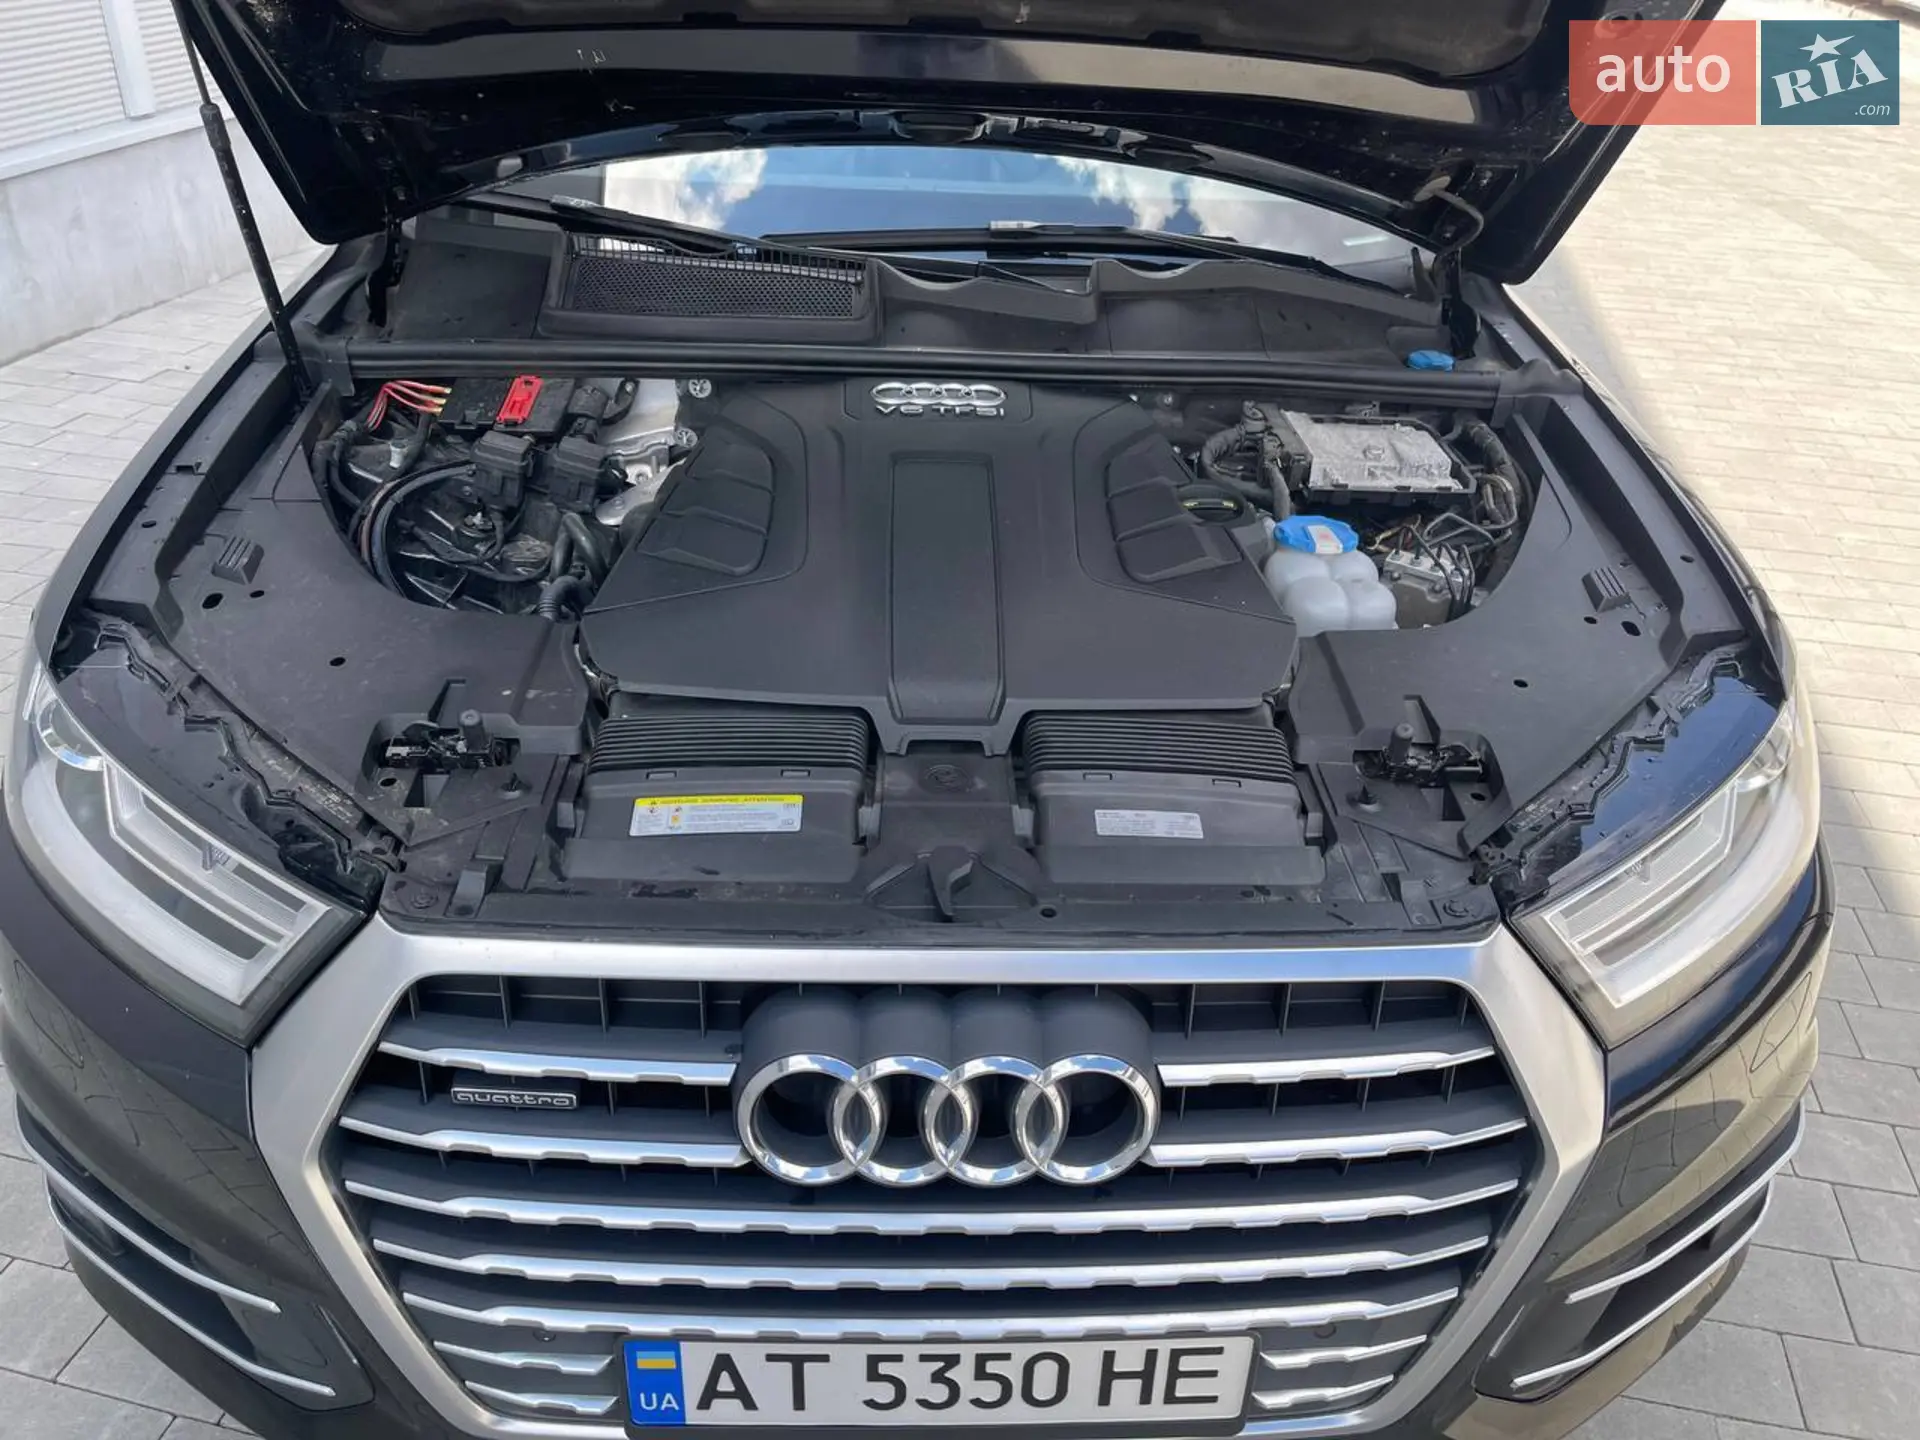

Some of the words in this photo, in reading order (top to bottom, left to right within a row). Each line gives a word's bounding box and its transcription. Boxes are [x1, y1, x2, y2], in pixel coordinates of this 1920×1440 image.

[456, 1093, 569, 1105] quattro
[696, 1353, 830, 1412] AT
[863, 1351, 1071, 1411] 5350
[1099, 1346, 1225, 1407] HE
[640, 1392, 680, 1412] UA
